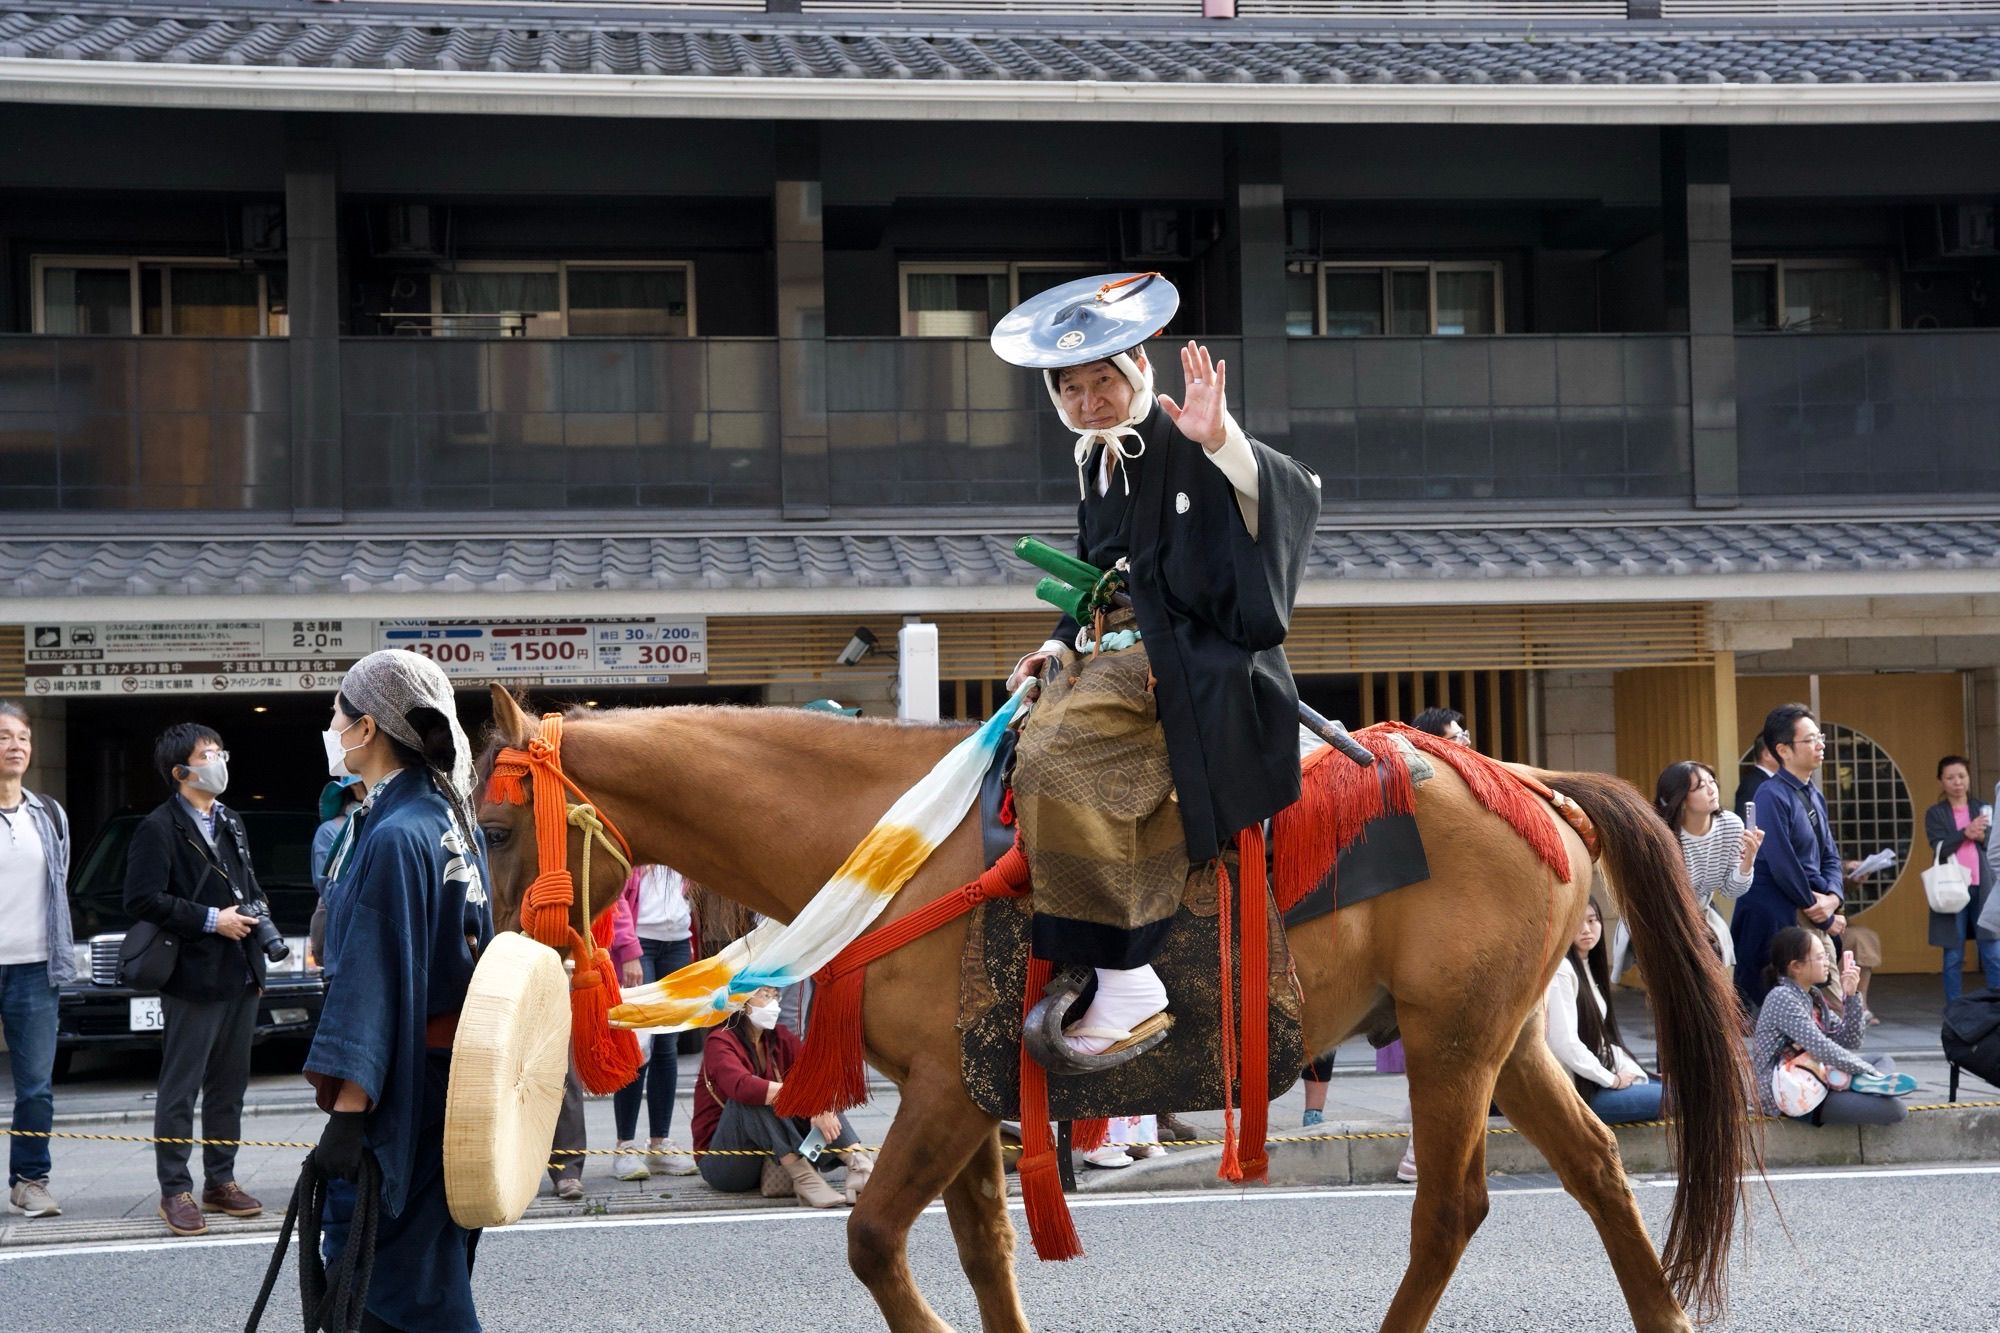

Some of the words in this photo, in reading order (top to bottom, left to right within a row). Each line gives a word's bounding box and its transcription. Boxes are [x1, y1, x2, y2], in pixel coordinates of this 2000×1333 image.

[292, 621, 343, 632] 高さ制限
[292, 633, 343, 647] 2.0m
[81, 662, 183, 675] 監視カメラ作動中
[222, 660, 337, 673] 不正駐車取締強化中
[53, 680, 102, 692] 場内禁煙
[230, 676, 283, 688] アイドリング禁止
